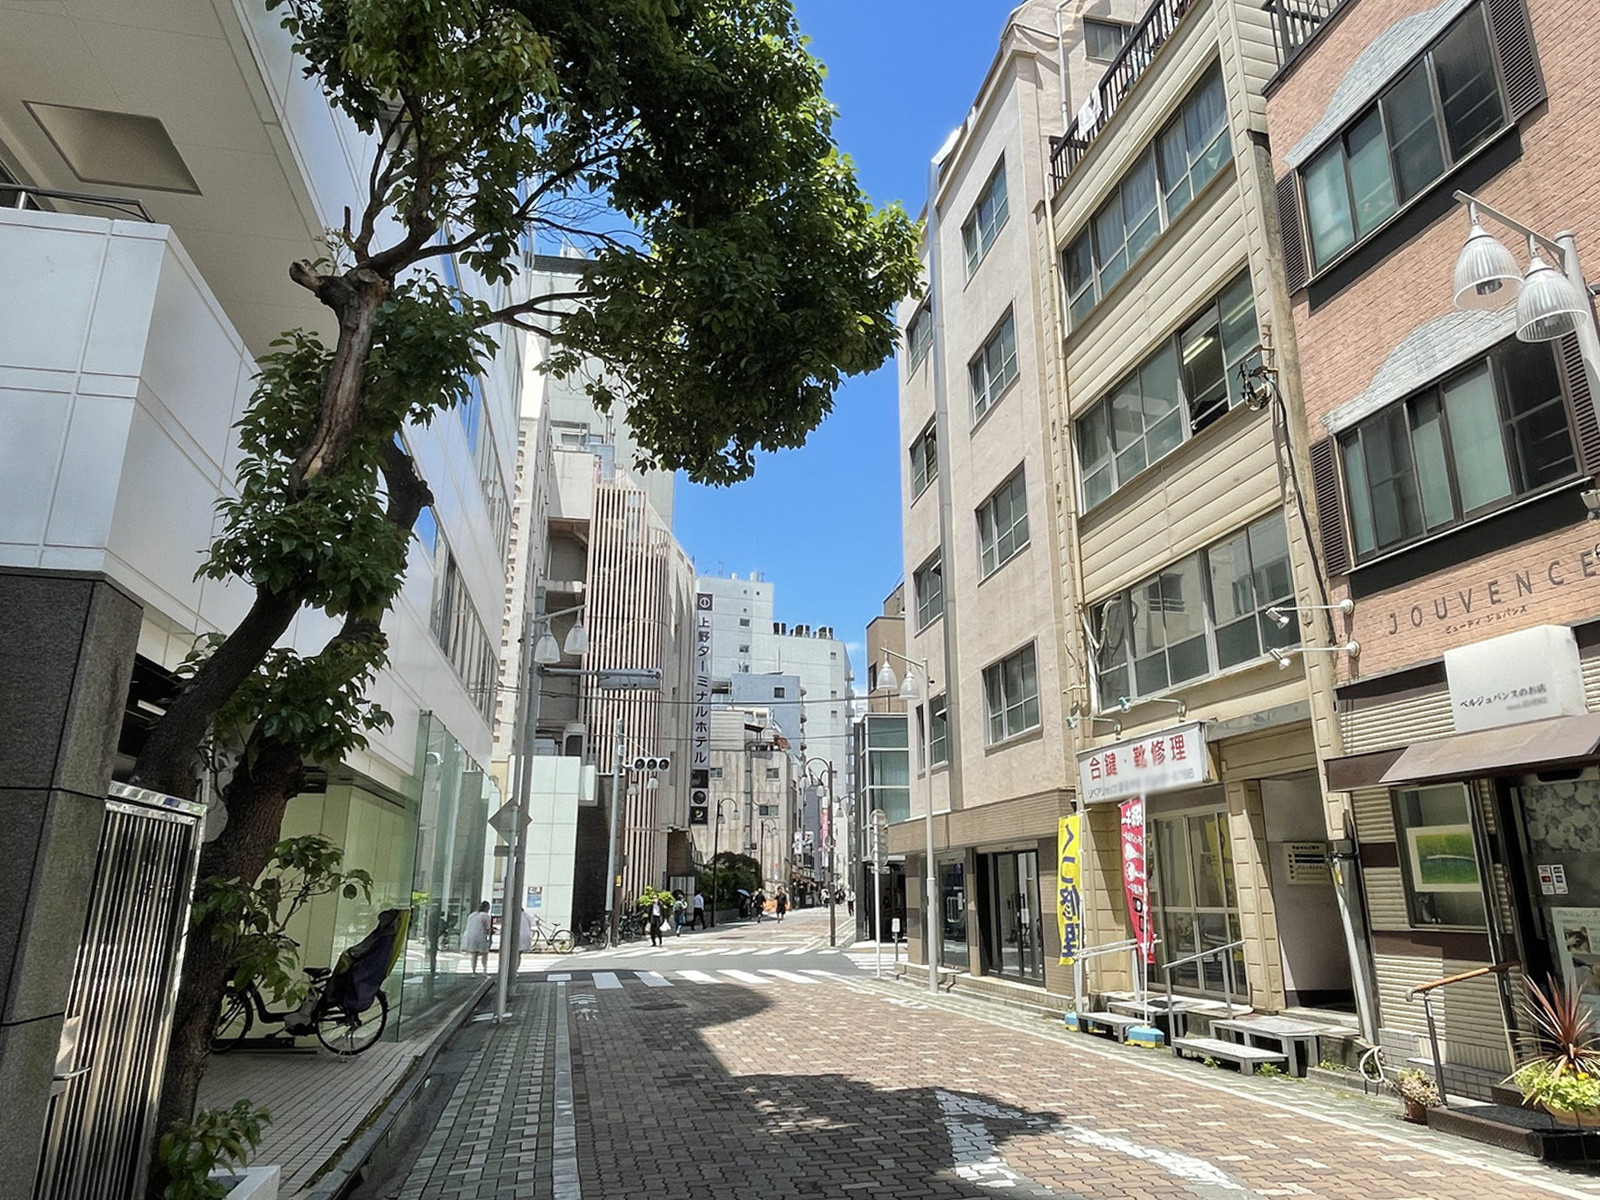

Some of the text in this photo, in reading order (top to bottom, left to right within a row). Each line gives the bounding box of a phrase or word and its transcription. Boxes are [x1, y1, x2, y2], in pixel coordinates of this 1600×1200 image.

[1388, 549, 1597, 635] JOUVENCE
[693, 616, 710, 764] 上野ターミナルホテル
